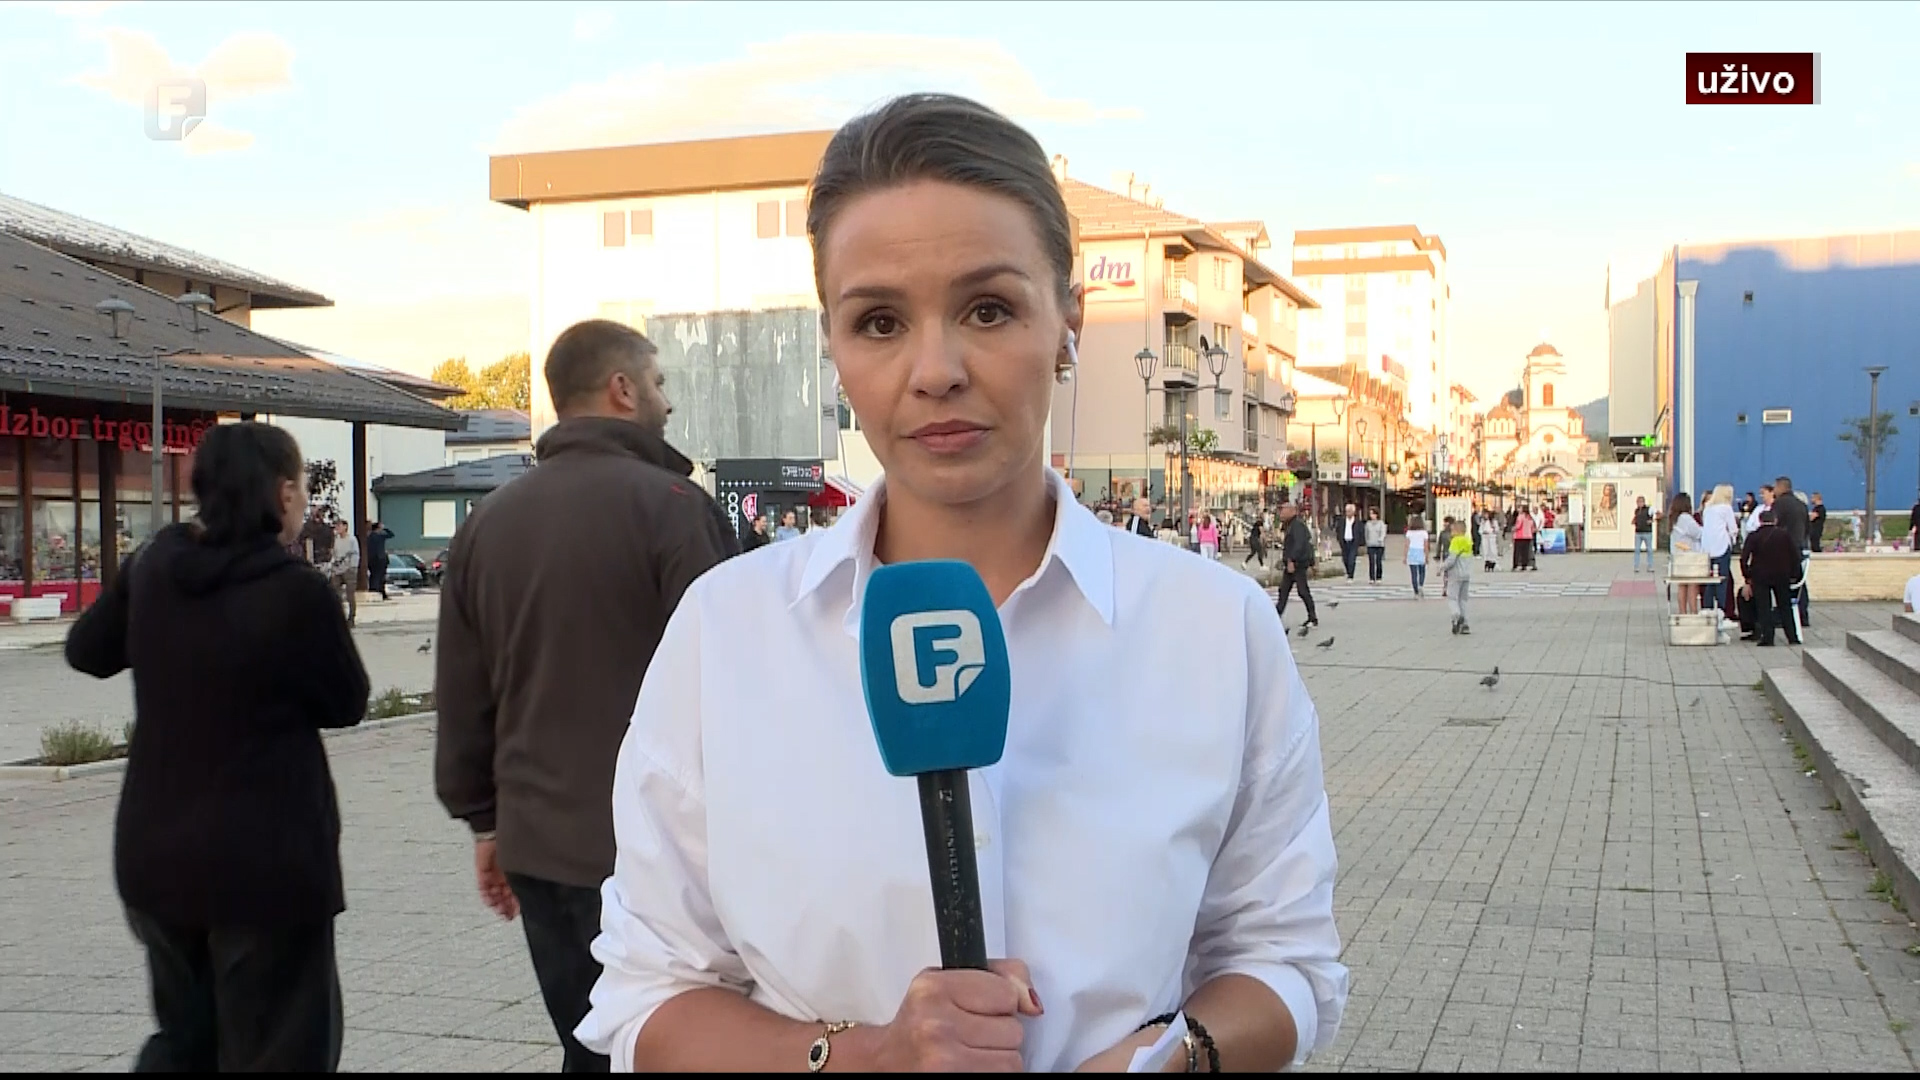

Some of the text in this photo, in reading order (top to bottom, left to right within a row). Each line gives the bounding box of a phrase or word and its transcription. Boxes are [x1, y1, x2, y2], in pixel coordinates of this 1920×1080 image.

[1090, 255, 1131, 281] dm
[0, 404, 206, 451] Izbor trgoine
